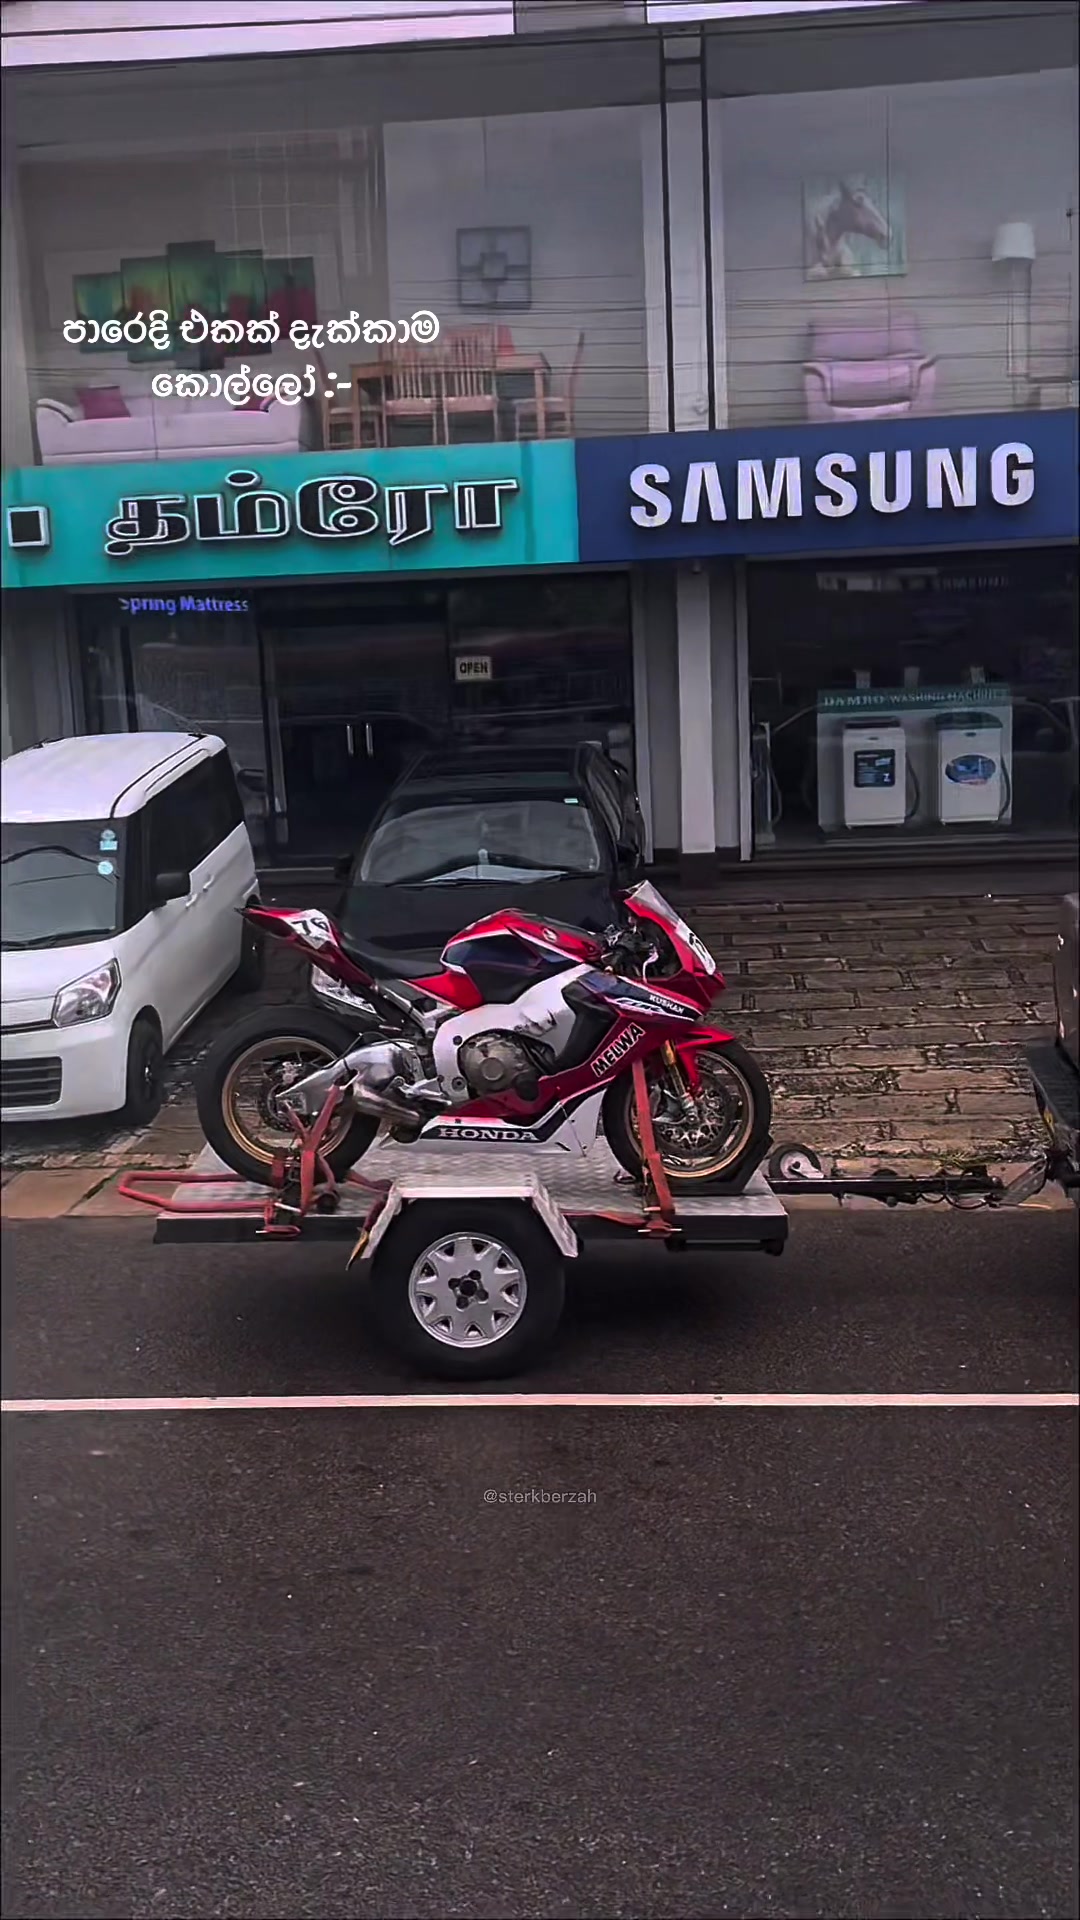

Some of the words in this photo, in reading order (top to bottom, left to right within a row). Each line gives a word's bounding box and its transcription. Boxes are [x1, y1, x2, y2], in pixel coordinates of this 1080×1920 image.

[629, 442, 1035, 528] SAMSUNG
[104, 470, 518, 556] தம்ரோ
[180, 596, 248, 611] Mattress
[459, 661, 488, 675] OPEN
[591, 1022, 646, 1078] MELWA
[439, 1127, 540, 1141] HONDA
